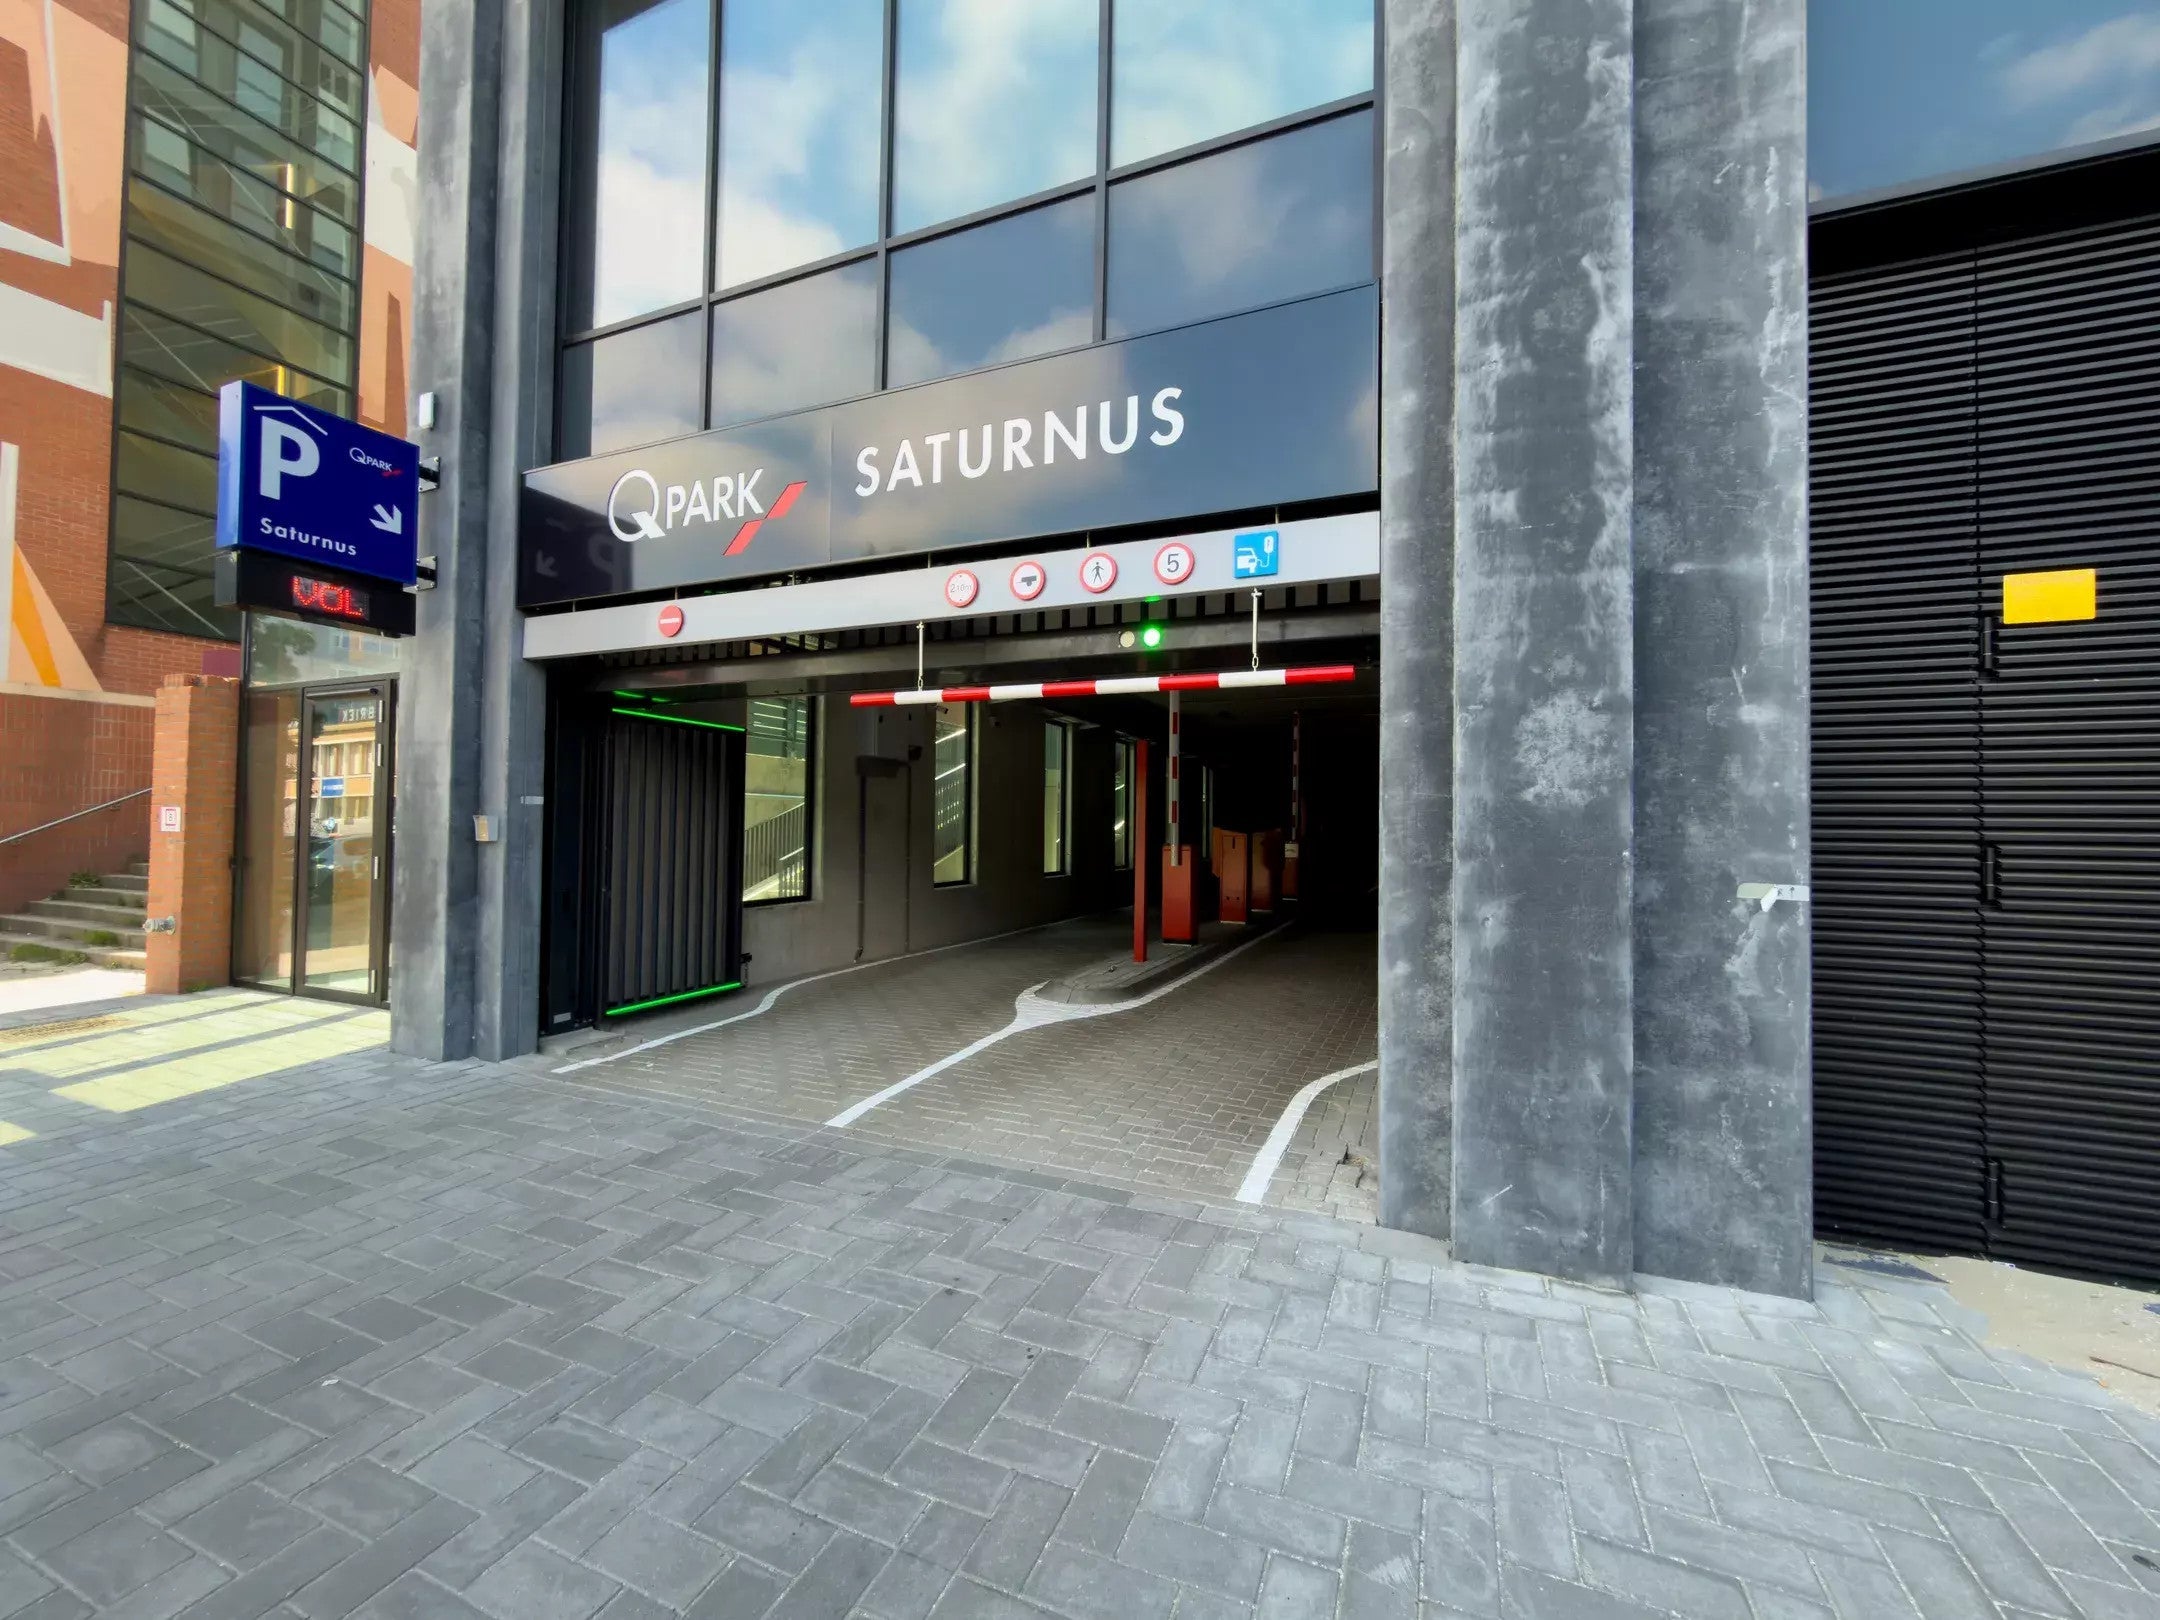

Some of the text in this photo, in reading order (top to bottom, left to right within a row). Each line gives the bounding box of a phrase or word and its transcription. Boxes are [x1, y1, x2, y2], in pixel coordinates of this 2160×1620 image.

[259, 415, 320, 500] P
[855, 387, 1184, 497] SATURNUS
[260, 517, 357, 556] Saturnus
[1167, 553, 1179, 573] 5
[293, 575, 362, 616] VOL
